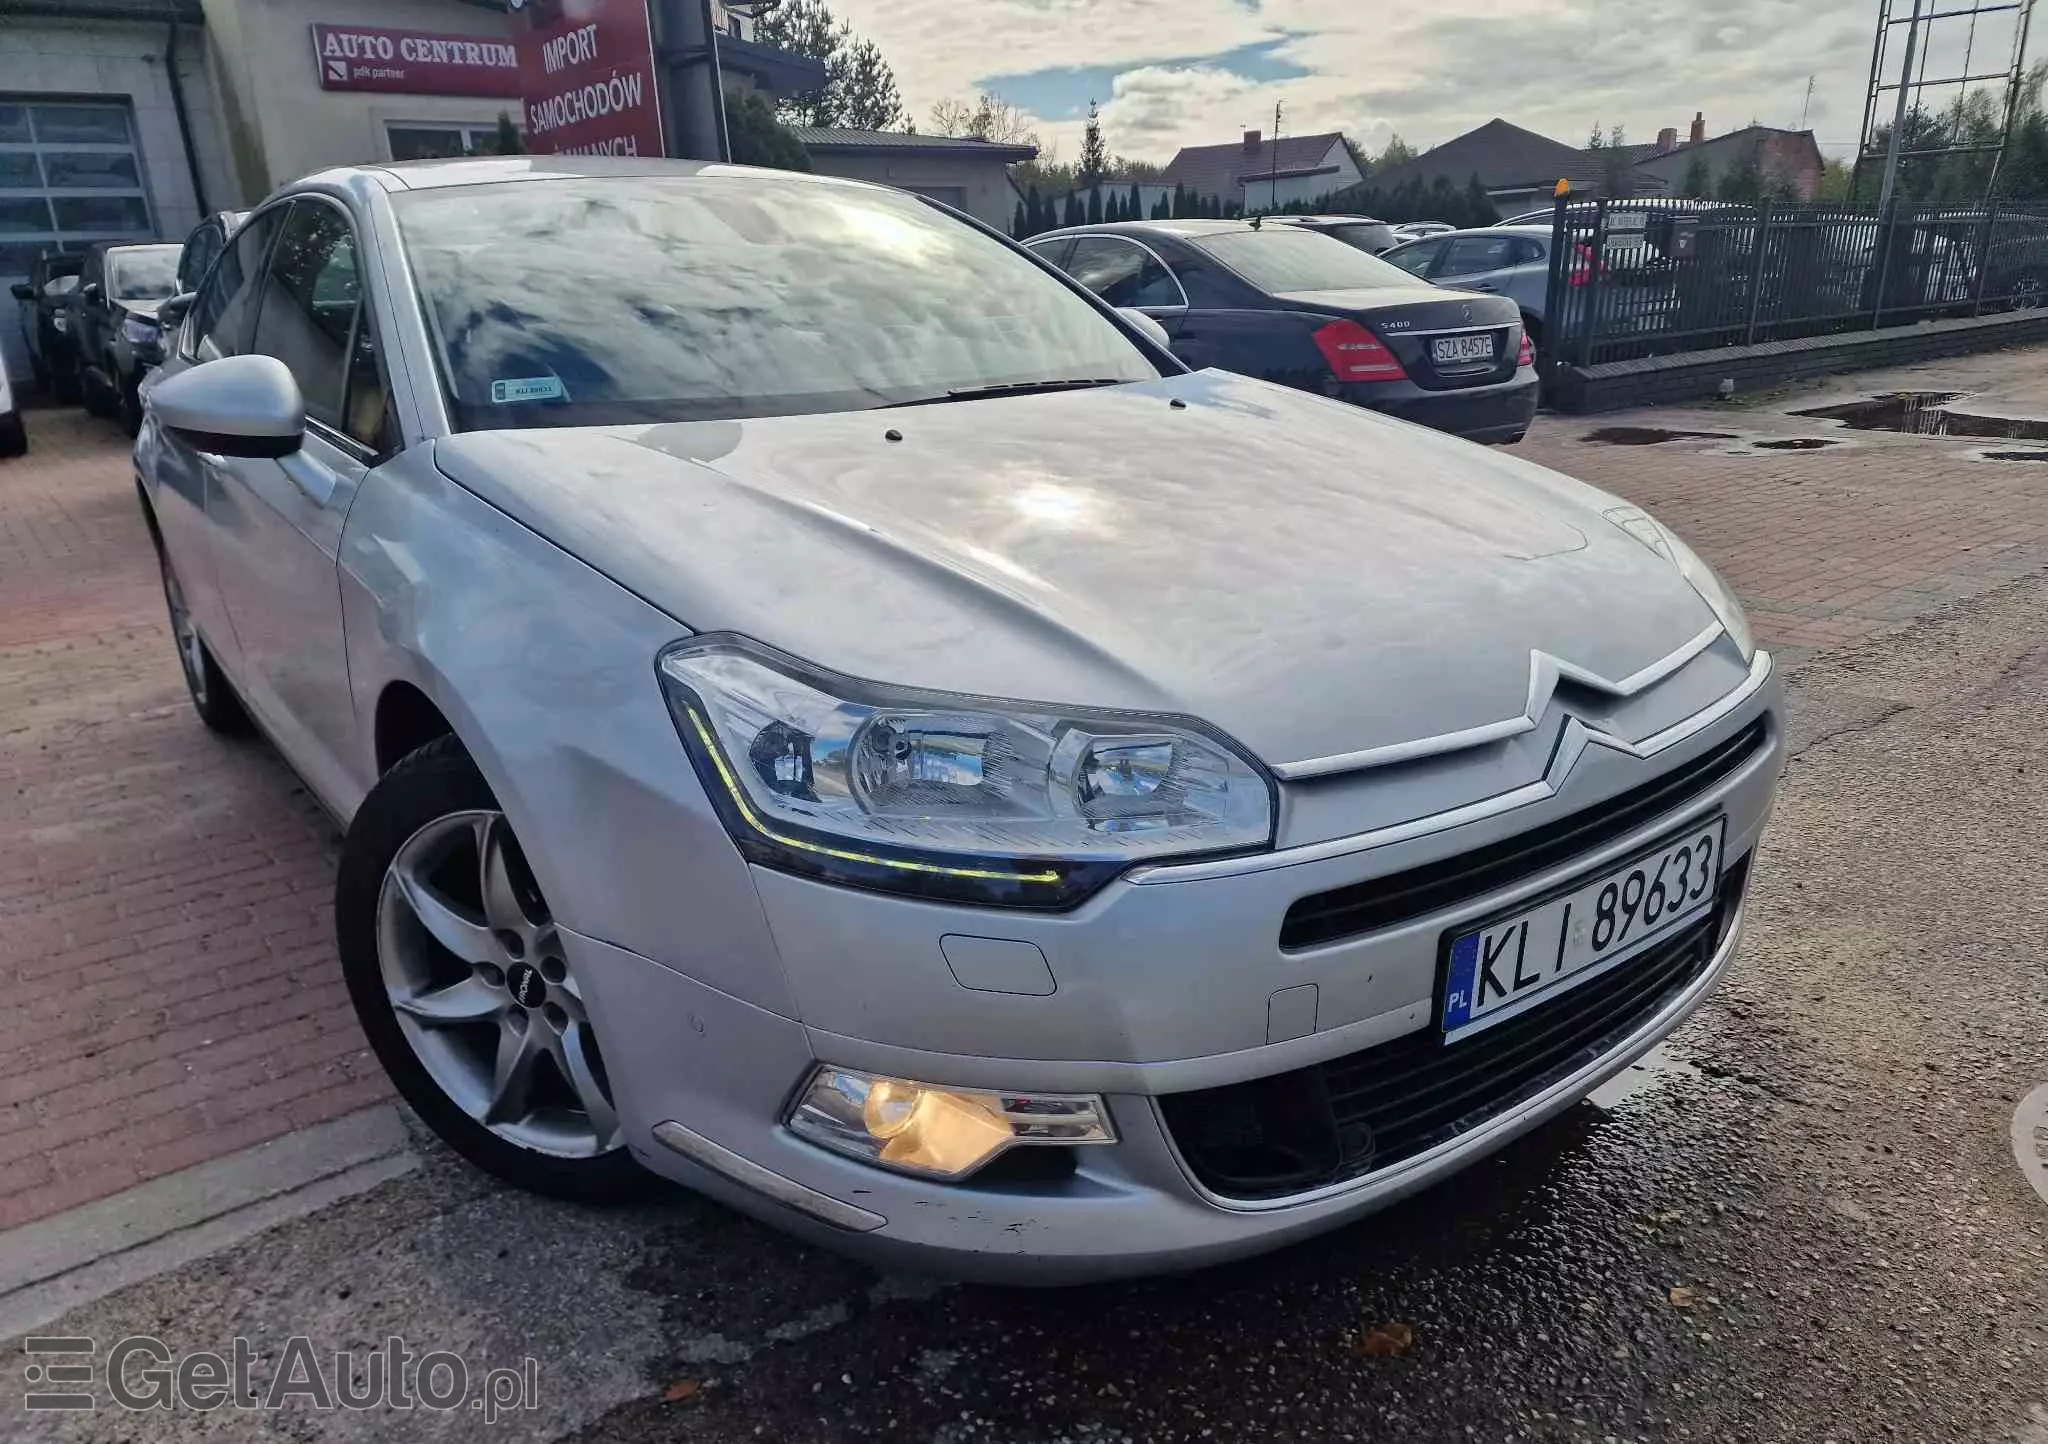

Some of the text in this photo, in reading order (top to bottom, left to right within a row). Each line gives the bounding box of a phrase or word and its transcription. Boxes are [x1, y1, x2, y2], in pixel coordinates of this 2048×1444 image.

[323, 33, 518, 68] AUTO CENTRUM
[543, 24, 598, 74] IMPORT
[530, 70, 641, 135] SAMOCHODÓW
[1381, 320, 1410, 330] S400
[1437, 339, 1458, 360] SZA
[1592, 835, 1713, 952] 89633
[1448, 990, 1468, 1014] PL
